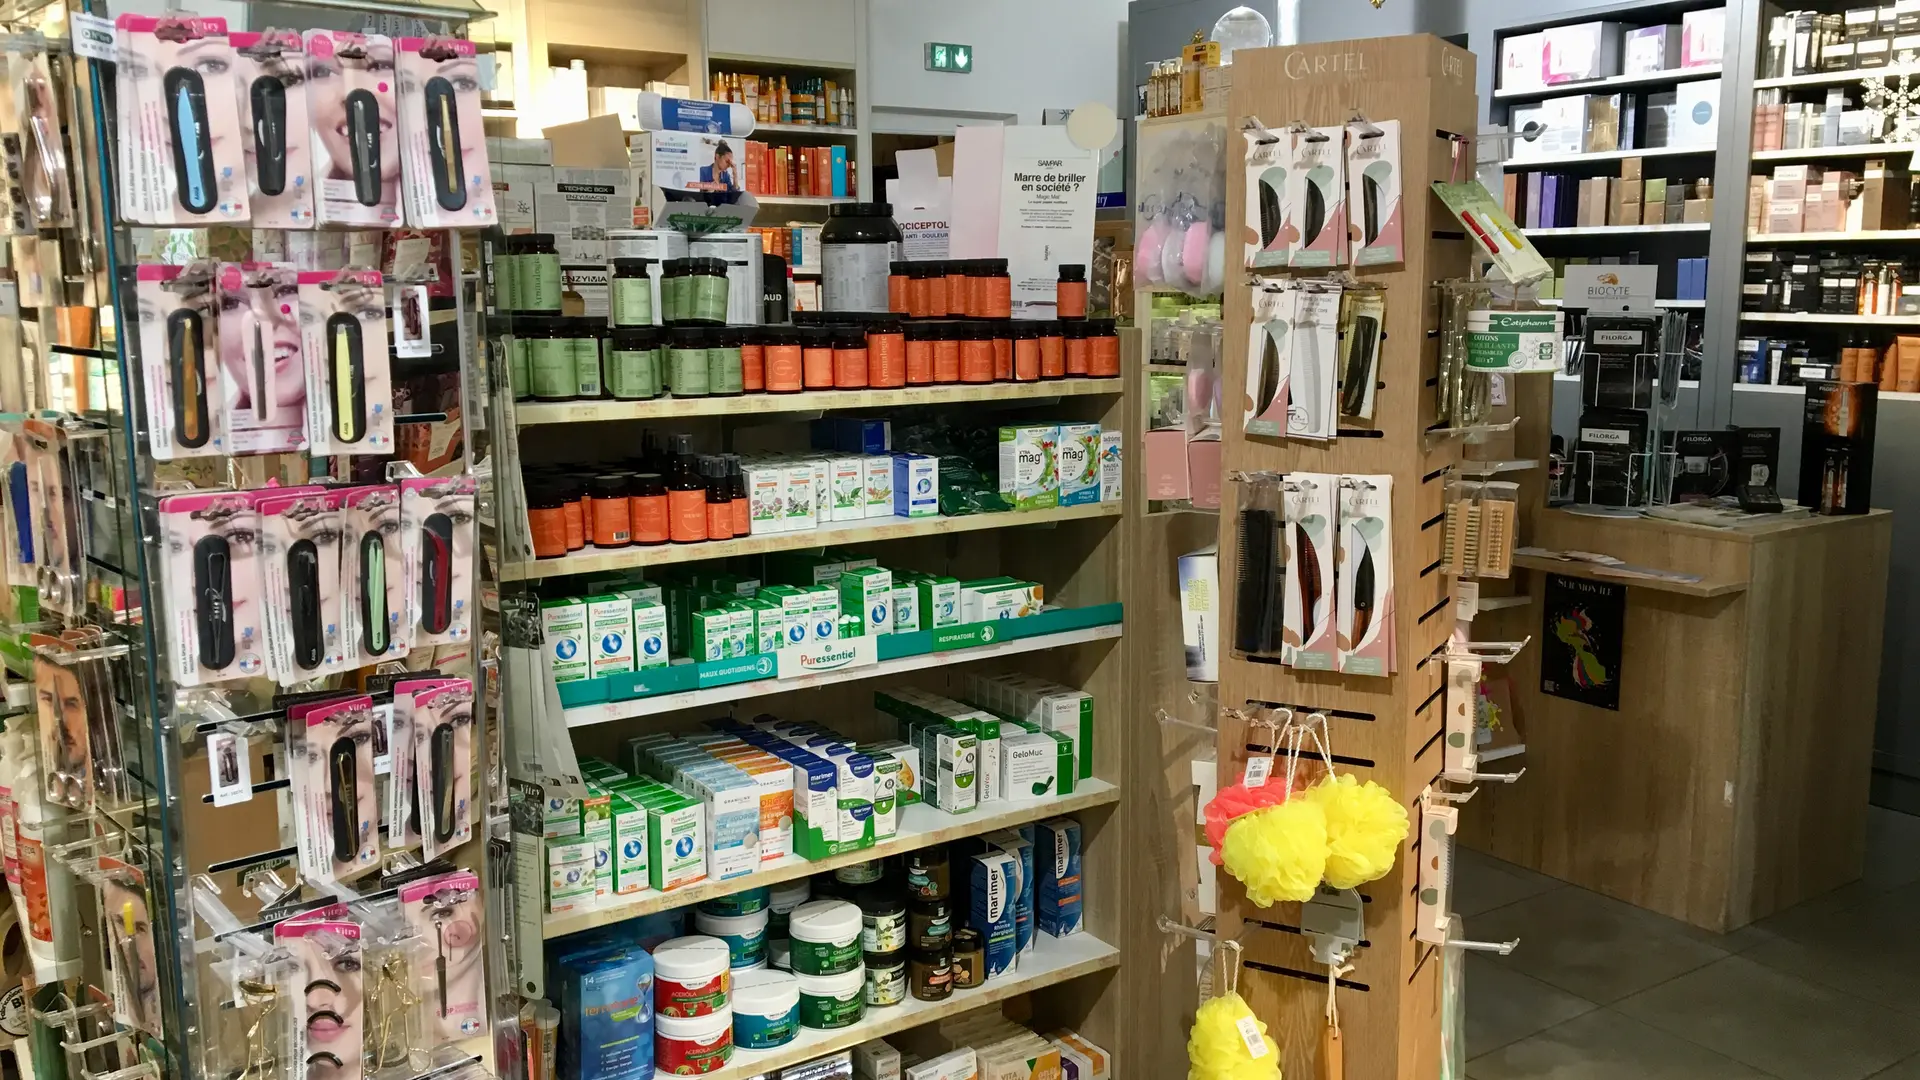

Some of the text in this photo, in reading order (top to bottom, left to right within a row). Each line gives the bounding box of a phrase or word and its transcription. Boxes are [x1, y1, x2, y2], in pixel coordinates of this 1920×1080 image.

[1284, 51, 1368, 80] CARTEL
[1441, 47, 1463, 78] CARTEL
[1014, 172, 1086, 182] Marre de briller
[1021, 182, 1080, 192] en société ?
[1587, 286, 1630, 296] BIOCYTE
[1500, 317, 1548, 327] Estipharm
[1473, 334, 1499, 342] COTONS
[880, 335, 888, 385] Aromalogie
[1588, 432, 1620, 440] FILORGA
[547, 610, 583, 621] Puressentiel
[593, 605, 628, 616] Puressentiel
[637, 611, 665, 621] Puressentiel
[595, 618, 627, 627] RESPIRATOIRE
[938, 632, 975, 643] RESPIRATOIRE
[800, 646, 856, 666] Puressentiel
[700, 664, 756, 679] MAUX QUOTIDIENS
[1012, 749, 1043, 759] GeloMuc
[854, 763, 872, 771] marimer
[810, 771, 834, 781] marimer
[520, 784, 541, 797] Vitry
[854, 806, 872, 814] marimer
[449, 879, 472, 890] Vitry
[989, 867, 999, 921] marimer
[321, 906, 343, 918] Vitry
[993, 923, 1011, 931] Rhinite
[335, 927, 357, 938] Vitry
[990, 927, 1014, 938] allergique
[832, 943, 858, 956] CHLORELLE
[584, 976, 595, 986] 14
[436, 1007, 454, 1017] SOP
[1001, 1071, 1017, 1080] VITA
